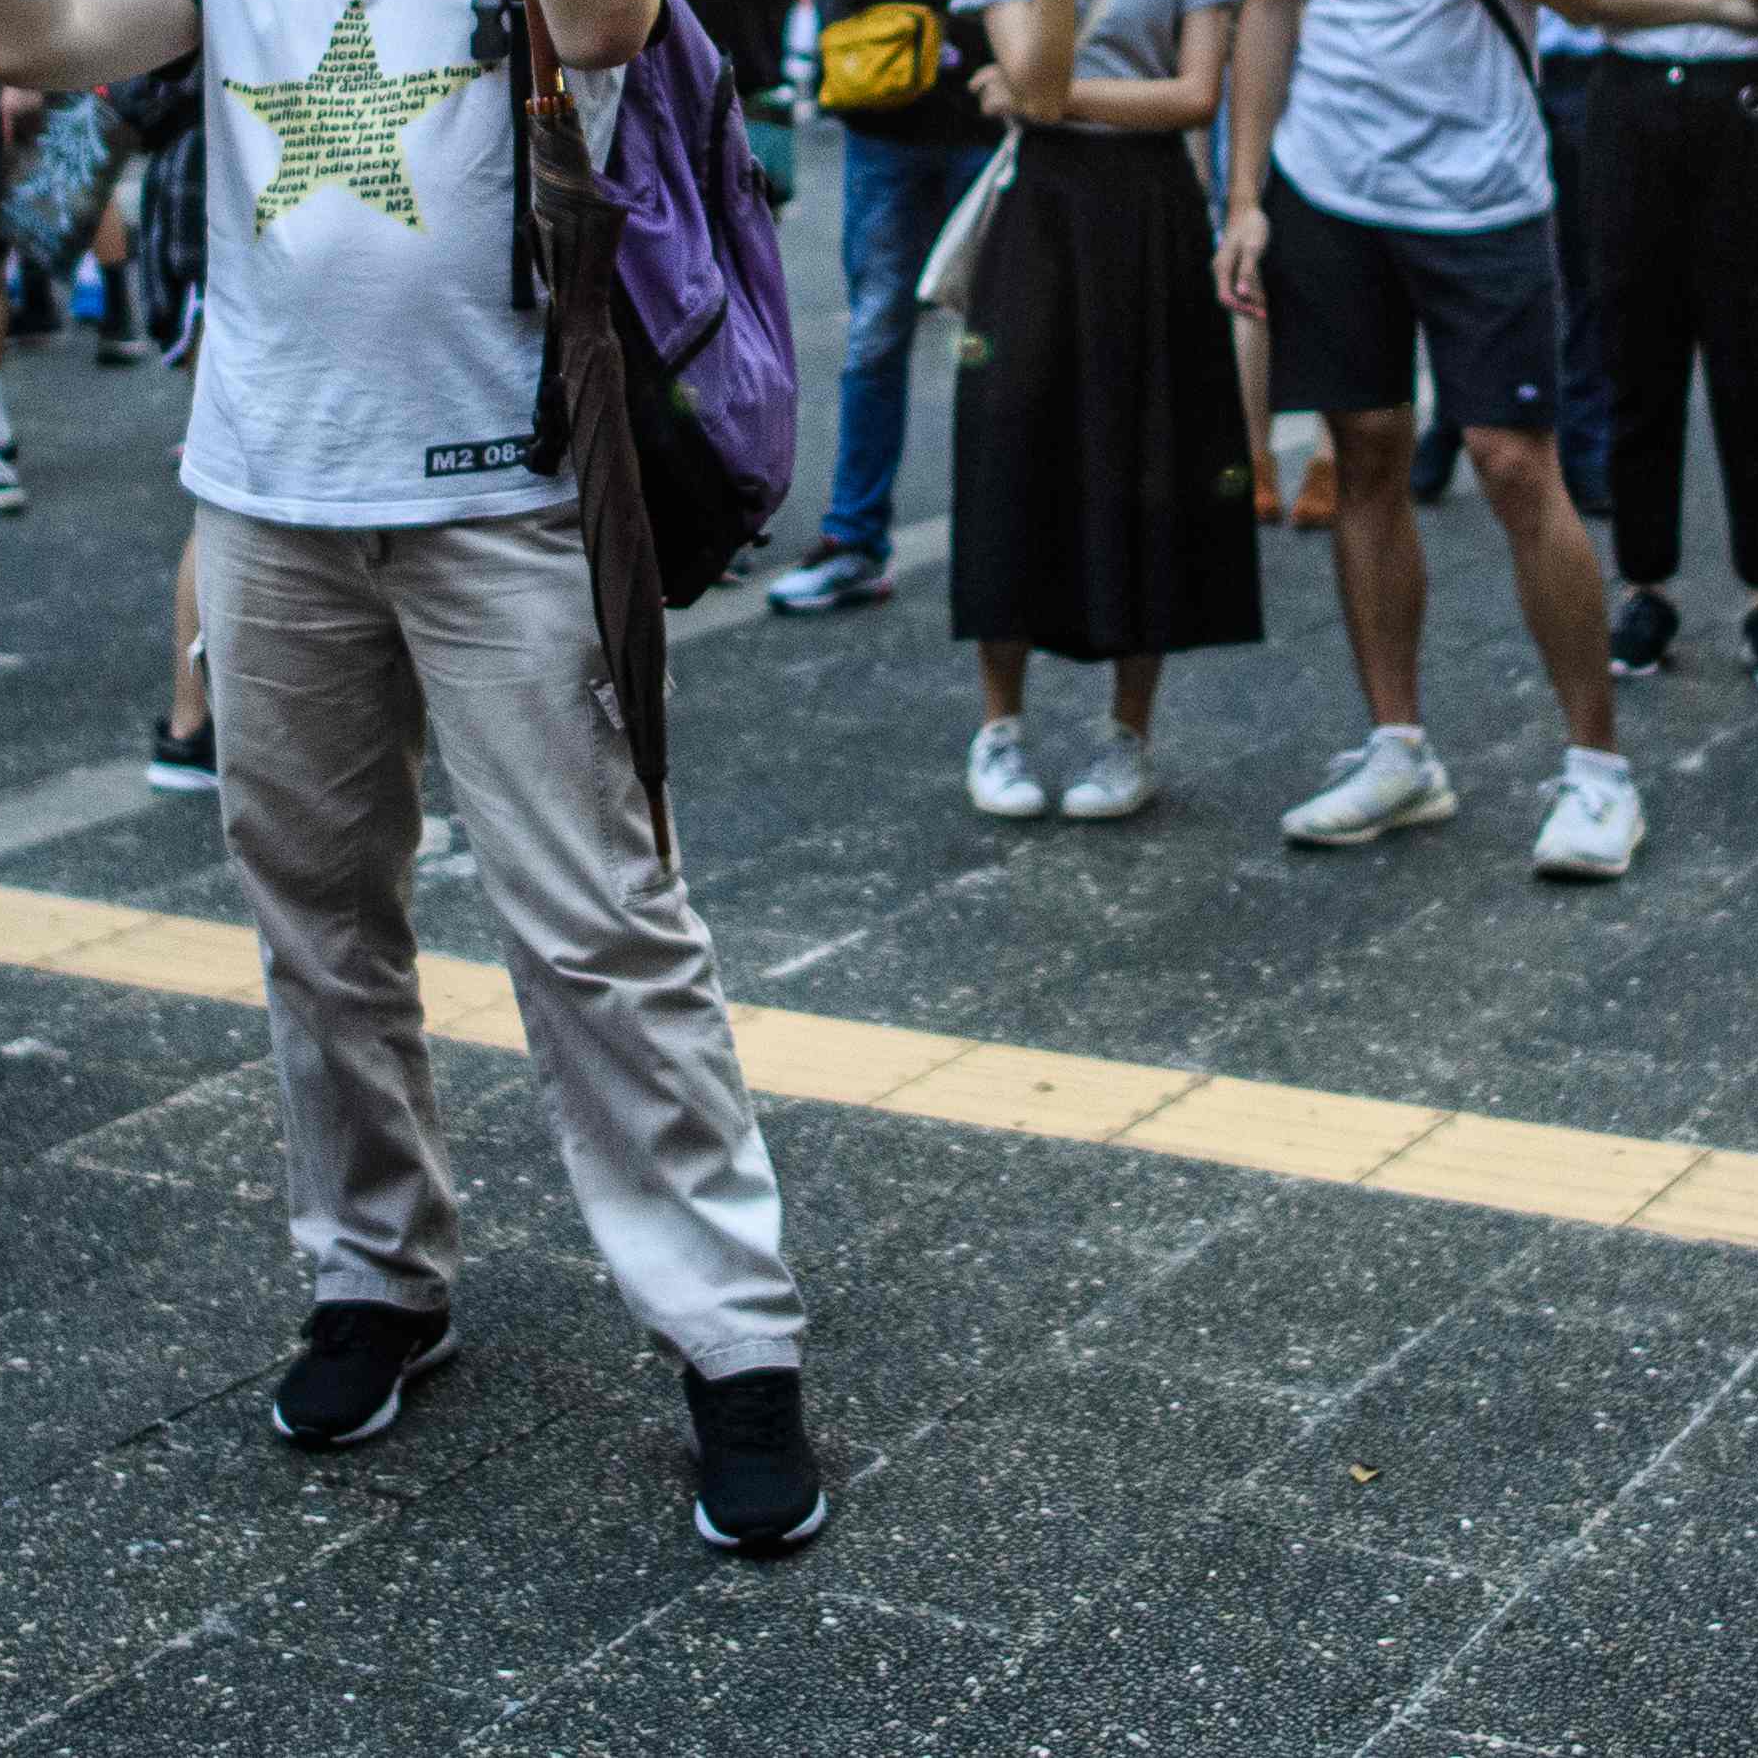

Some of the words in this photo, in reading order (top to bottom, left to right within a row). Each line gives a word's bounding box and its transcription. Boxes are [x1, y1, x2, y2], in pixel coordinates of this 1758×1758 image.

[343, 9, 365, 20] ho
[334, 21, 369, 32] amy
[330, 34, 372, 48] polly
[323, 48, 376, 61] nicola
[317, 62, 379, 73] horace
[278, 80, 333, 93] vincent
[338, 78, 397, 92] duncan
[402, 69, 436, 86] jack
[444, 66, 482, 79] fung
[309, 71, 383, 83] marcello
[254, 95, 302, 111] kenneth
[307, 94, 355, 106] helen
[362, 90, 402, 104] alvin
[406, 83, 450, 99] ricky
[268, 108, 312, 122] saffron
[316, 107, 366, 121] pinky
[371, 96, 426, 115] rachel
[278, 124, 306, 136] alex
[310, 121, 375, 132] chester
[382, 117, 408, 128] leo
[284, 134, 352, 148] matthew
[357, 131, 395, 145] jane
[282, 151, 321, 162] oscar
[326, 146, 372, 159] diana
[379, 143, 395, 153] lo
[276, 165, 310, 183] janet
[314, 162, 354, 178] jodie
[357, 159, 400, 174] jacky
[348, 172, 402, 187] sarah
[266, 180, 308, 194] derek
[360, 189, 381, 199] we
[386, 187, 410, 197] are
[258, 196, 279, 205] we
[386, 198, 413, 212] M2
[256, 208, 277, 220] M2
[433, 448, 474, 471] M2
